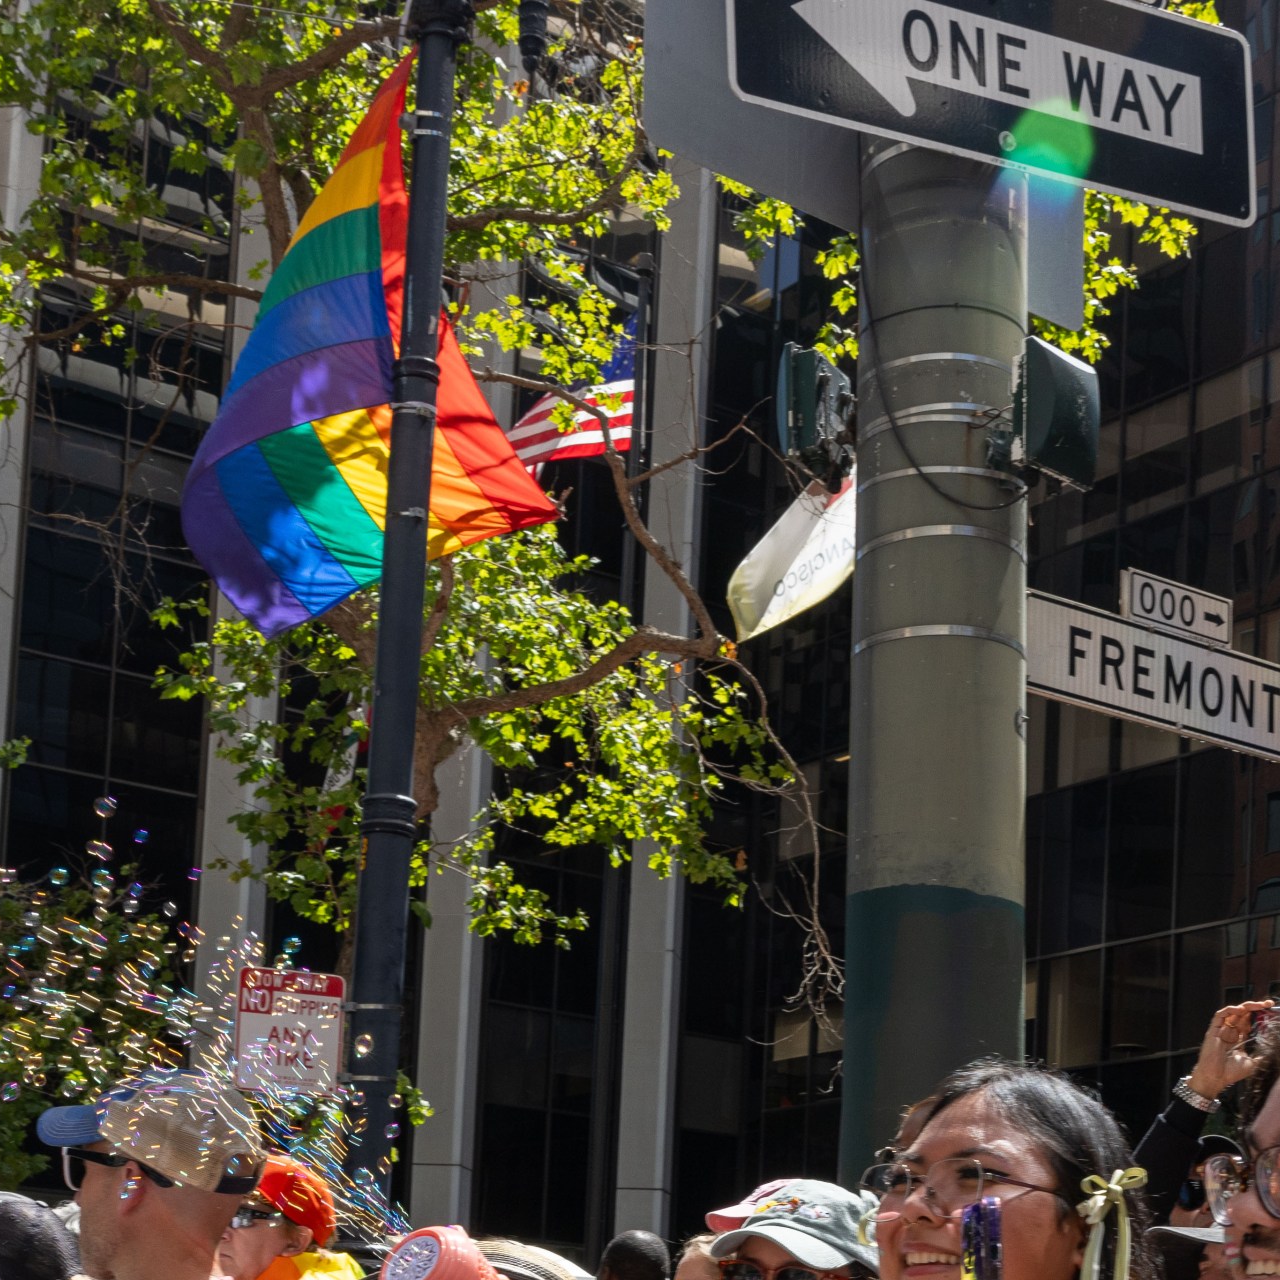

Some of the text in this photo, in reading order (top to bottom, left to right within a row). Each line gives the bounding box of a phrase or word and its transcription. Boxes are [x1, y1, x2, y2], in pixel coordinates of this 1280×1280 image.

[902, 10, 1187, 138] ONE WAY
[241, 987, 272, 1012] NO
[268, 1025, 313, 1045] ANY
[264, 1047, 314, 1069] TIME
